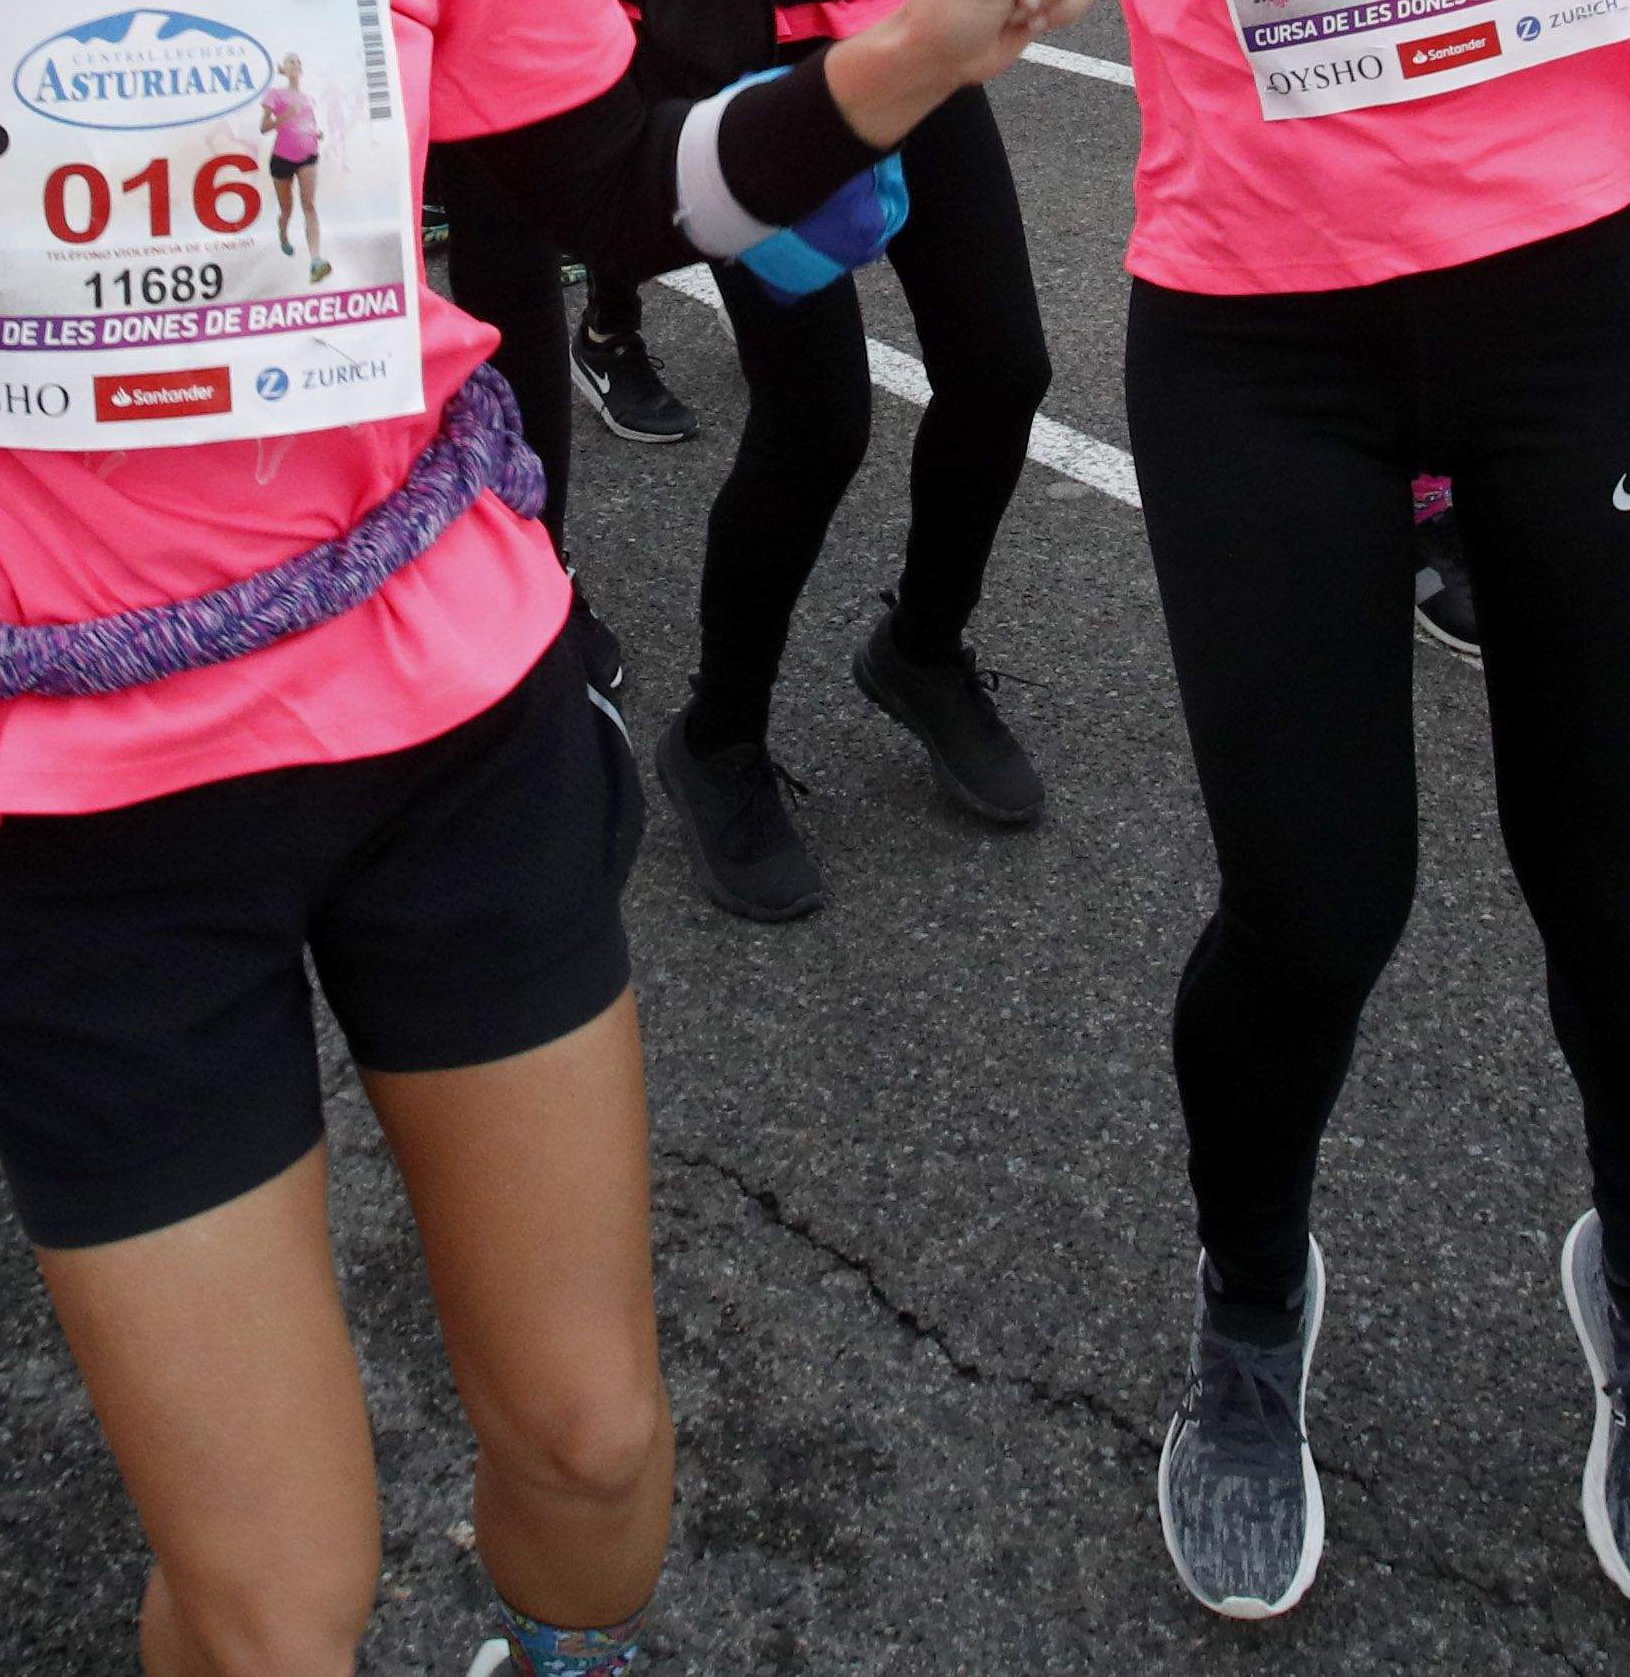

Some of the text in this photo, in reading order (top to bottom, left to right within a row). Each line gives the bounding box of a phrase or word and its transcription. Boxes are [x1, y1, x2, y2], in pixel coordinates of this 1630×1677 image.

[1255, 19, 1319, 47] CURSA
[1323, 13, 1350, 35] DE
[1354, 3, 1392, 28] LES
[72, 44, 246, 65] CENTRAL LECHERA
[1427, 36, 1487, 61] Santander
[35, 57, 255, 102] ASTURIANA
[1268, 55, 1383, 95] OYSHO
[43, 154, 261, 244] 016
[85, 263, 224, 308] 11689
[3, 321, 38, 345] DE
[44, 319, 96, 345] LES
[102, 313, 199, 344] DONES
[205, 308, 241, 336] DE
[249, 288, 398, 330] BARCELONA
[133, 384, 215, 406] Santander
[302, 359, 386, 390] ZURICH
